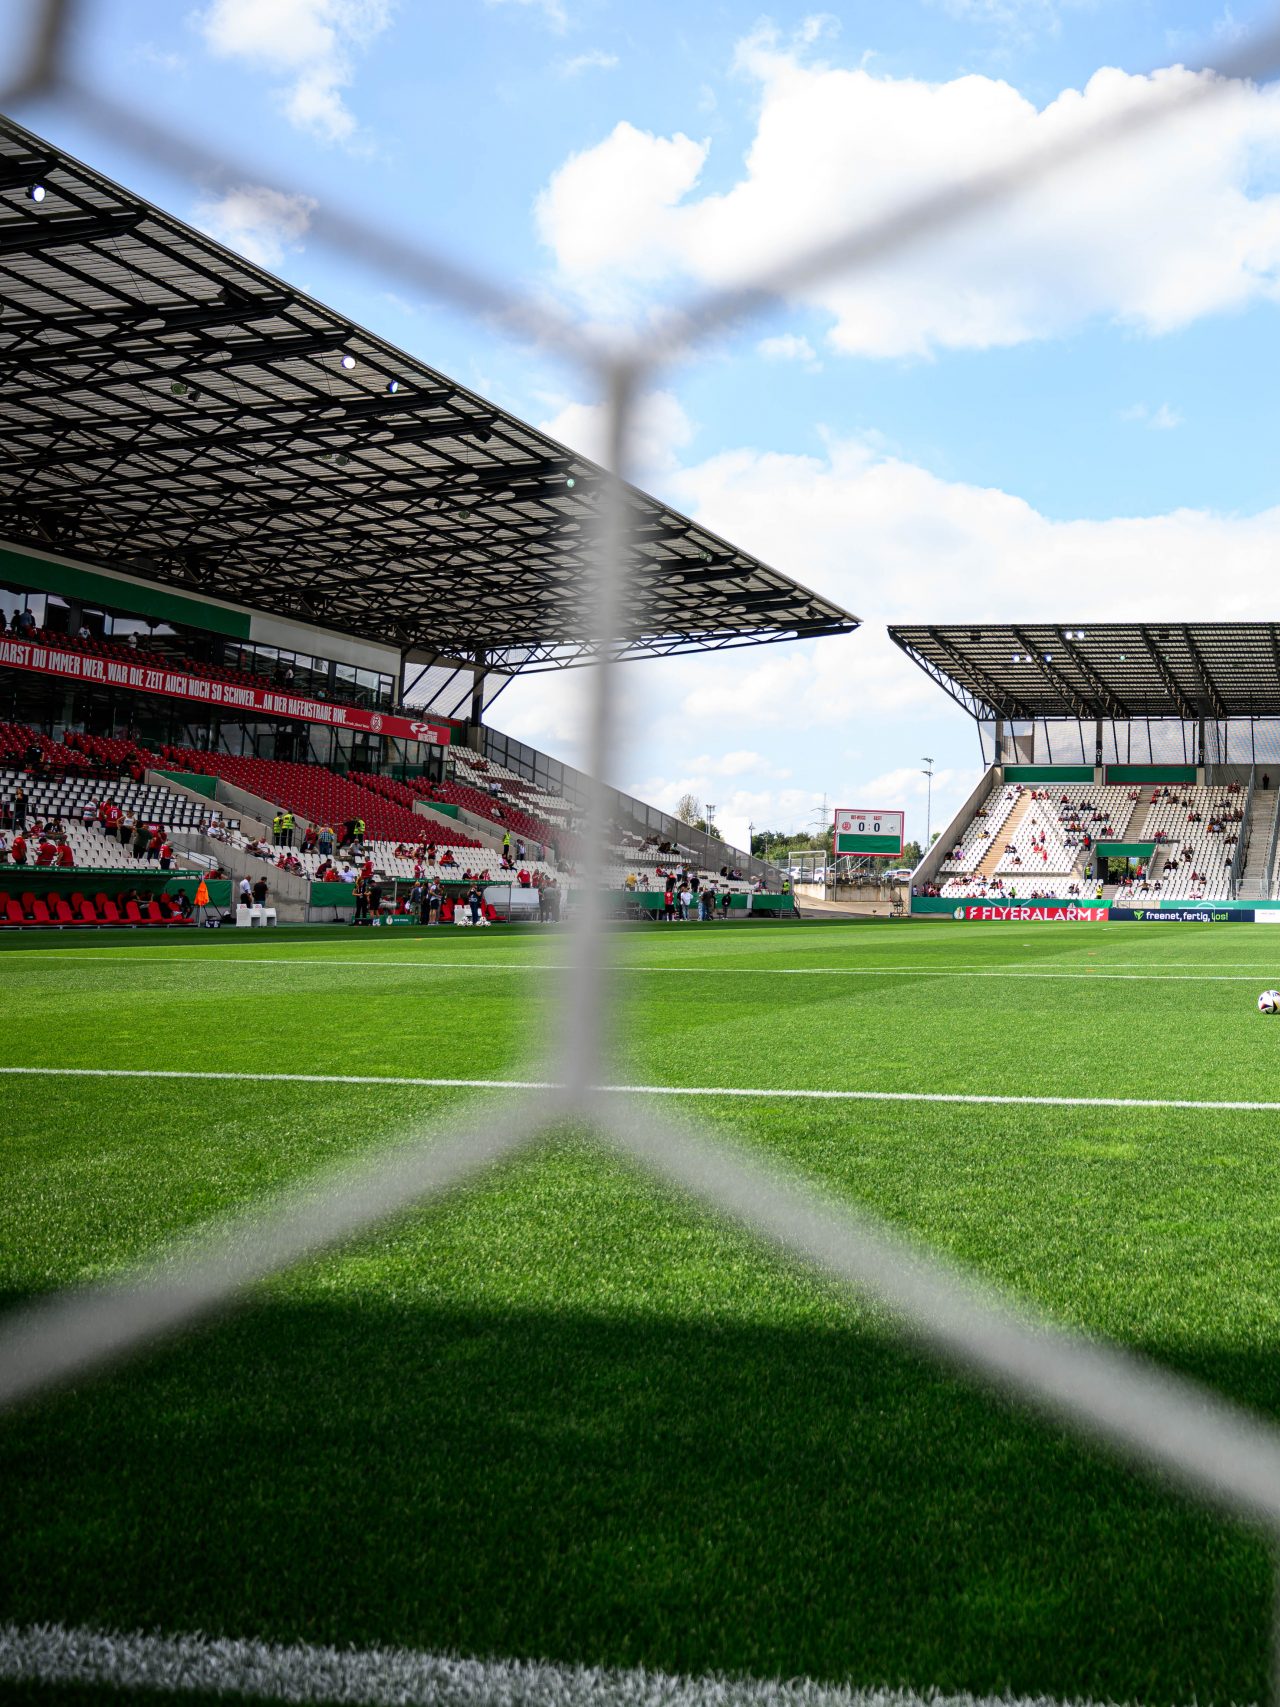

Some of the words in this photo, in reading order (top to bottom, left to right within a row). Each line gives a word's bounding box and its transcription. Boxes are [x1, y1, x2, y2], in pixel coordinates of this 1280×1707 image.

[32, 648, 47, 668] DU
[48, 651, 81, 675] IMMER
[82, 658, 106, 682] WER,
[107, 663, 128, 683] WAR
[129, 667, 144, 686] DIE
[145, 670, 164, 690] ZEIT
[165, 674, 187, 694] AUCH
[188, 678, 211, 699] NOCH
[211, 683, 222, 700] SO
[263, 694, 273, 710] AN
[273, 696, 287, 713] DER
[982, 907, 1091, 921] FLYERALARM
[1146, 911, 1182, 922] freenet,
[1183, 911, 1210, 922] fertig,
[1211, 911, 1229, 921] los!
